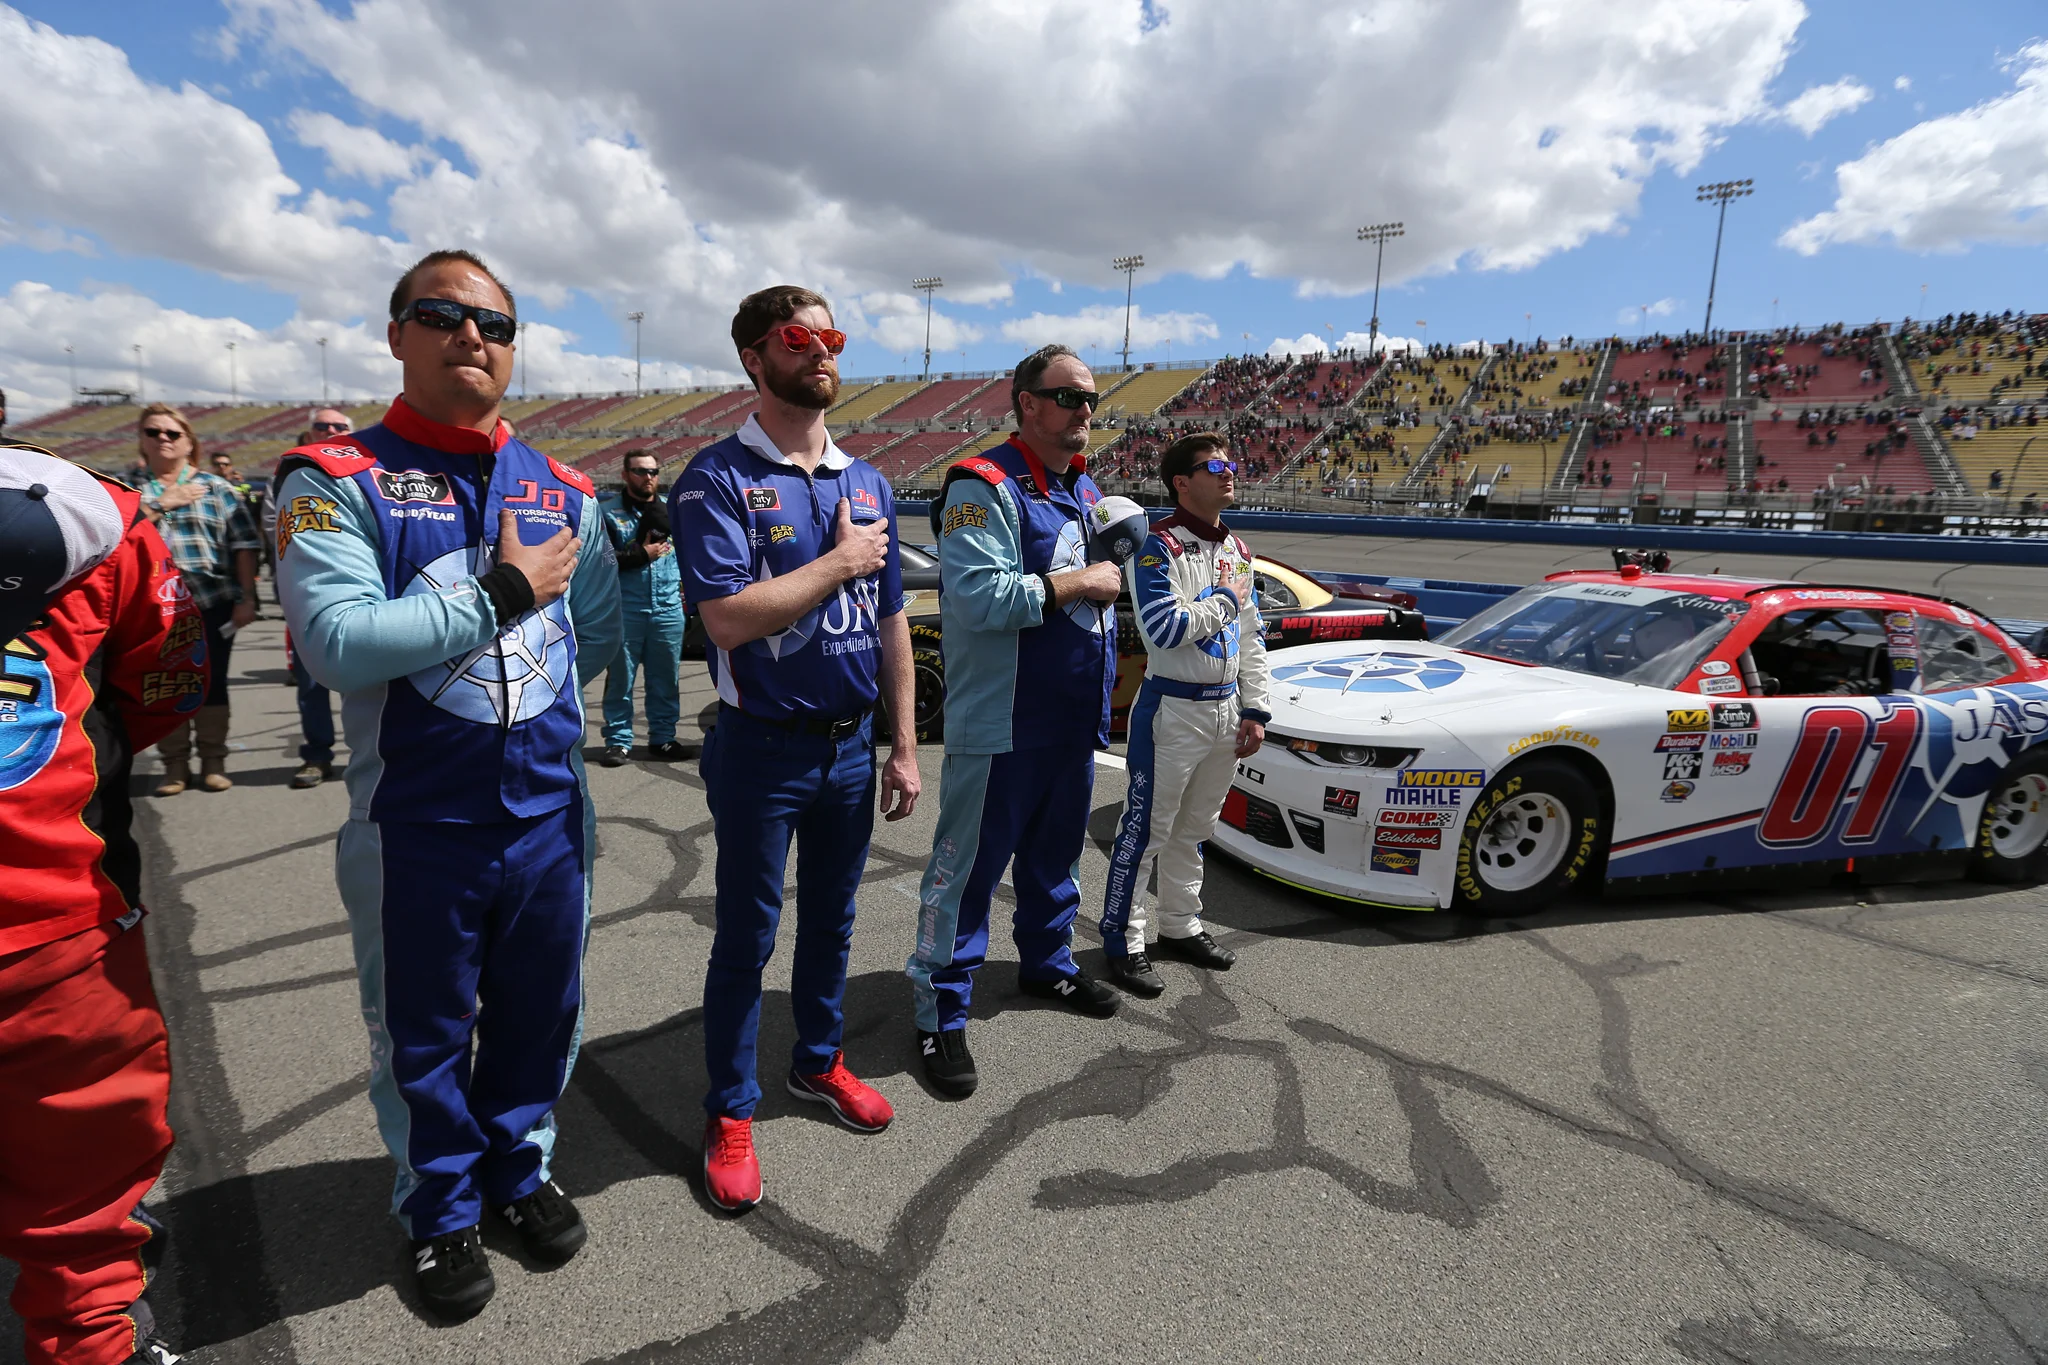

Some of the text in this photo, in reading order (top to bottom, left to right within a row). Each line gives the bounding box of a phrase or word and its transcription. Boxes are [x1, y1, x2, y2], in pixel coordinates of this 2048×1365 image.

[387, 482, 438, 498] xfinity
[390, 507, 455, 521] GOODYEAR
[510, 508, 567, 520] OTORSPORTS
[944, 503, 988, 524] FLEX
[770, 525, 794, 536] FLEX
[944, 515, 987, 538] SEAL
[772, 531, 796, 543] SEAL
[1581, 588, 1632, 598] MILLER
[1672, 596, 1747, 615] xfinity
[1281, 615, 1386, 630] MOTORHOME
[1310, 627, 1364, 639] PARTS
[143, 671, 204, 689] FLEX
[143, 684, 199, 706] SEAL
[1718, 710, 1751, 724] xfinity
[1956, 701, 2048, 742] JAS
[1507, 725, 1600, 756] GOODYEAR
[1662, 736, 1702, 747] Duralast
[1710, 734, 1744, 747] Mobil
[1710, 766, 1745, 777] MSD
[1756, 703, 1925, 850] 01
[1401, 772, 1482, 786] MOOG
[1386, 788, 1460, 805] MAHLE
[1131, 788, 1145, 823] JAS
[1380, 811, 1438, 824] COMP
[1376, 832, 1438, 845] Edelbrock
[1564, 818, 1597, 882] EAGLE
[1374, 855, 1418, 865] SUNOCO
[925, 857, 954, 908] JAS
